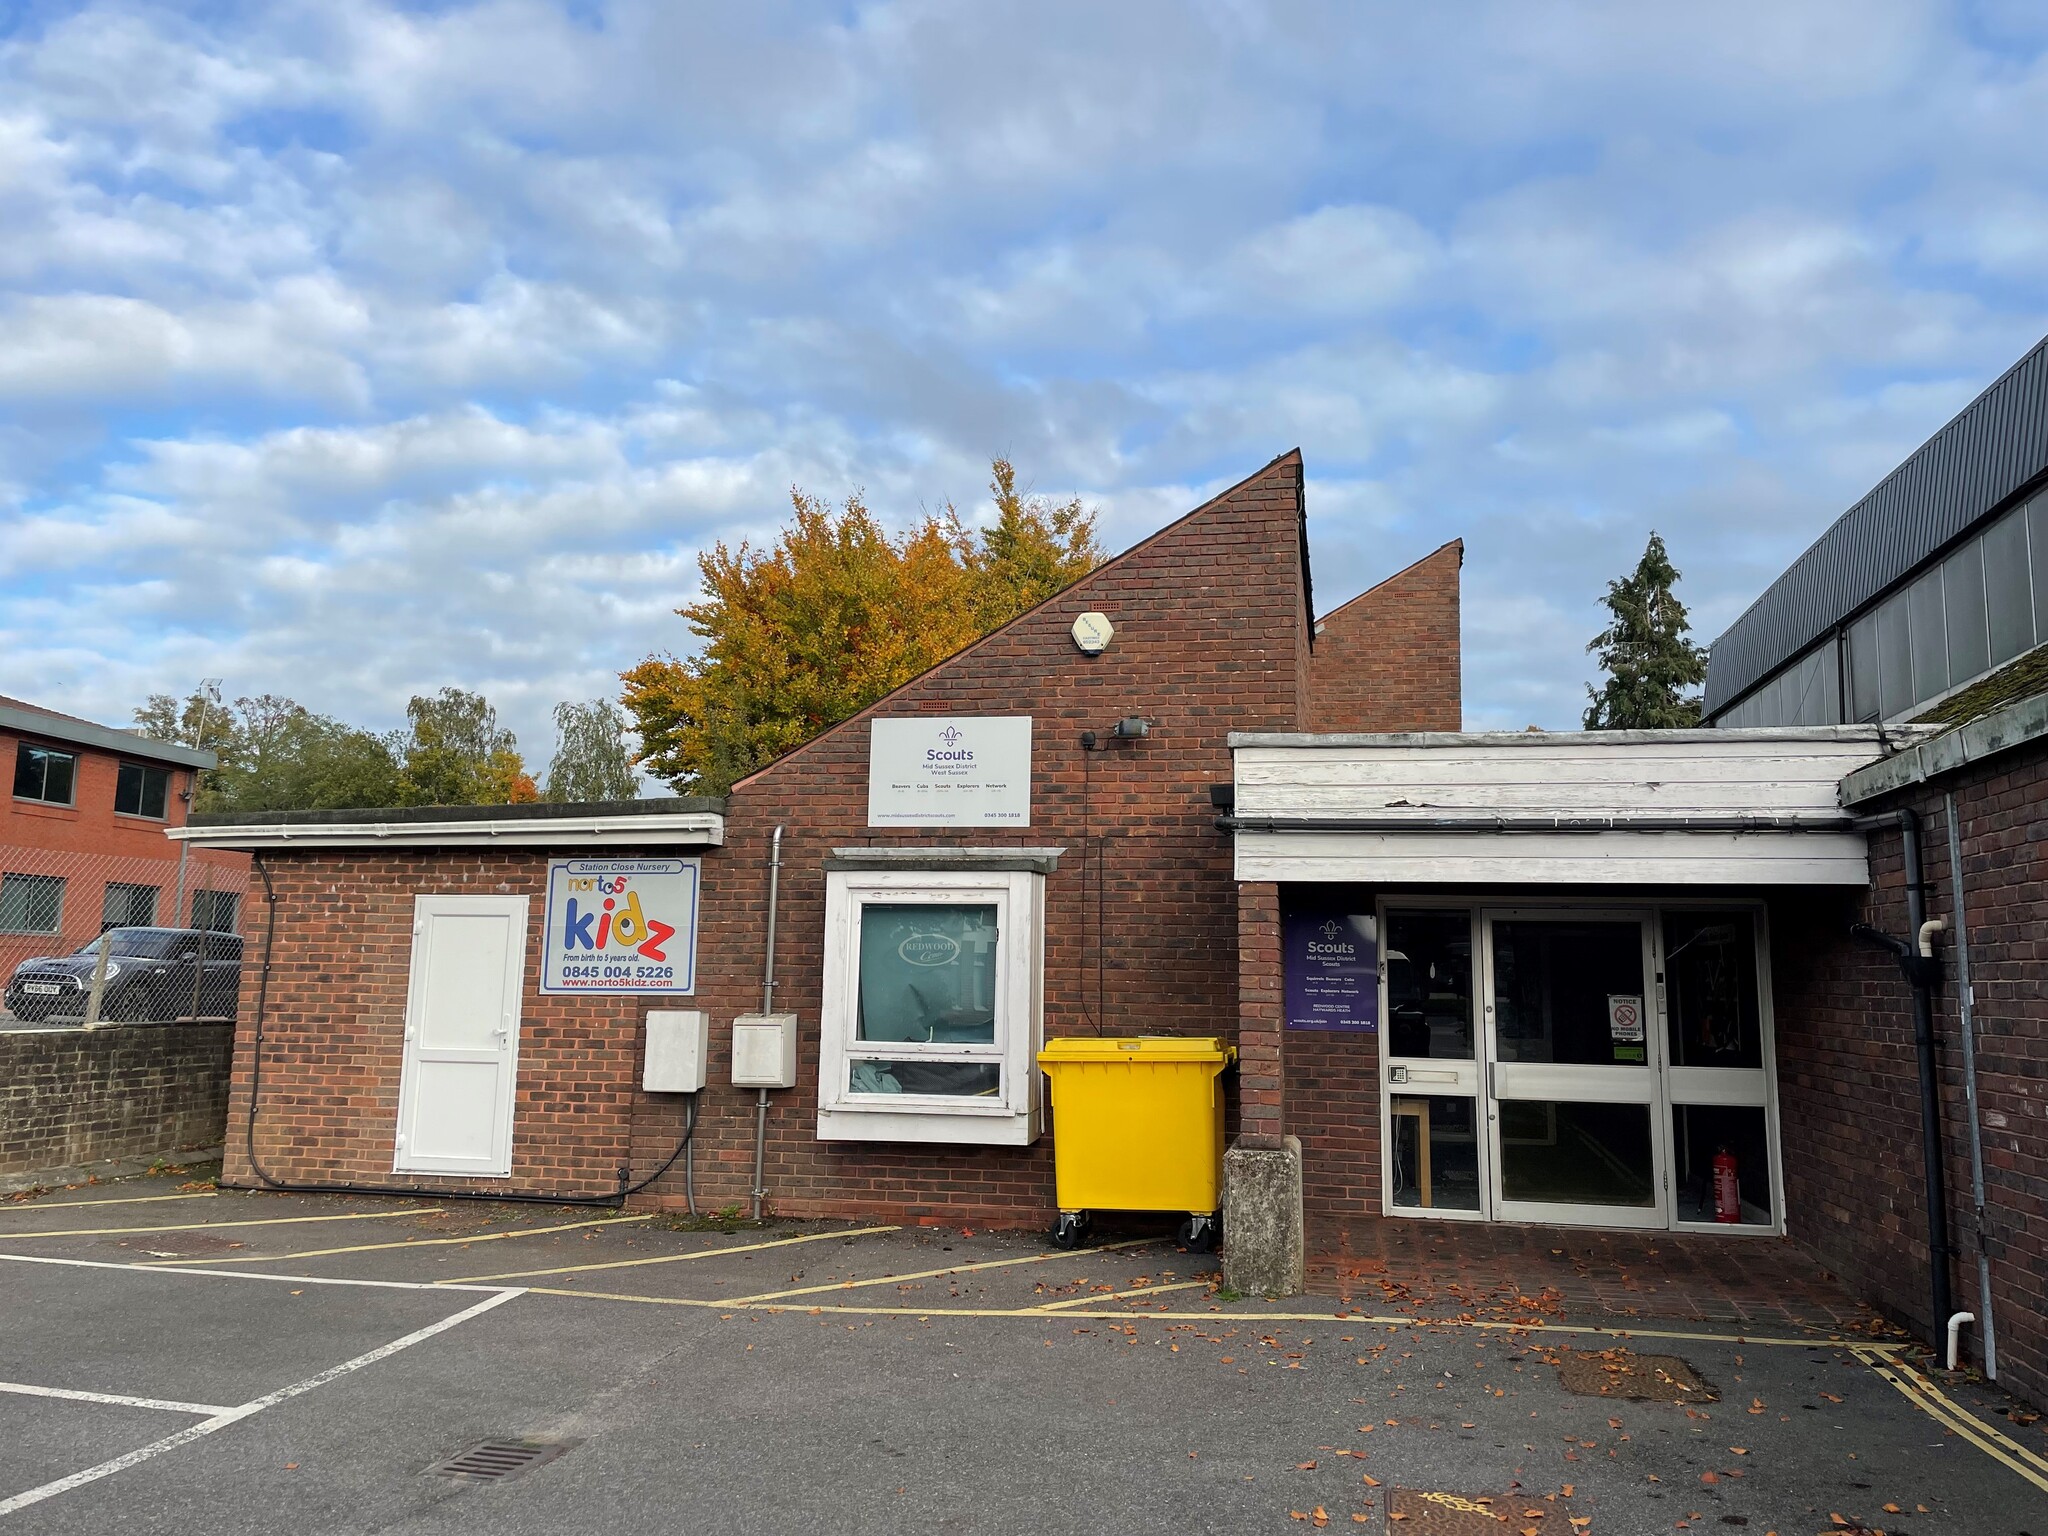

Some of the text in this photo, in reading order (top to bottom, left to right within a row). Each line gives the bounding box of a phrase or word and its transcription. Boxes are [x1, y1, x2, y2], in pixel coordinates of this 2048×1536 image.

[927, 749, 974, 761] Scouts
[579, 863, 671, 873] Station Close Nursery
[565, 891, 676, 962] kidz
[906, 943, 954, 951] REDWOOD
[1308, 941, 1355, 954] Scouts
[609, 955, 627, 963] years
[562, 966, 674, 978] 0845 004 5226
[562, 979, 673, 987] www.norto5kidz.com
